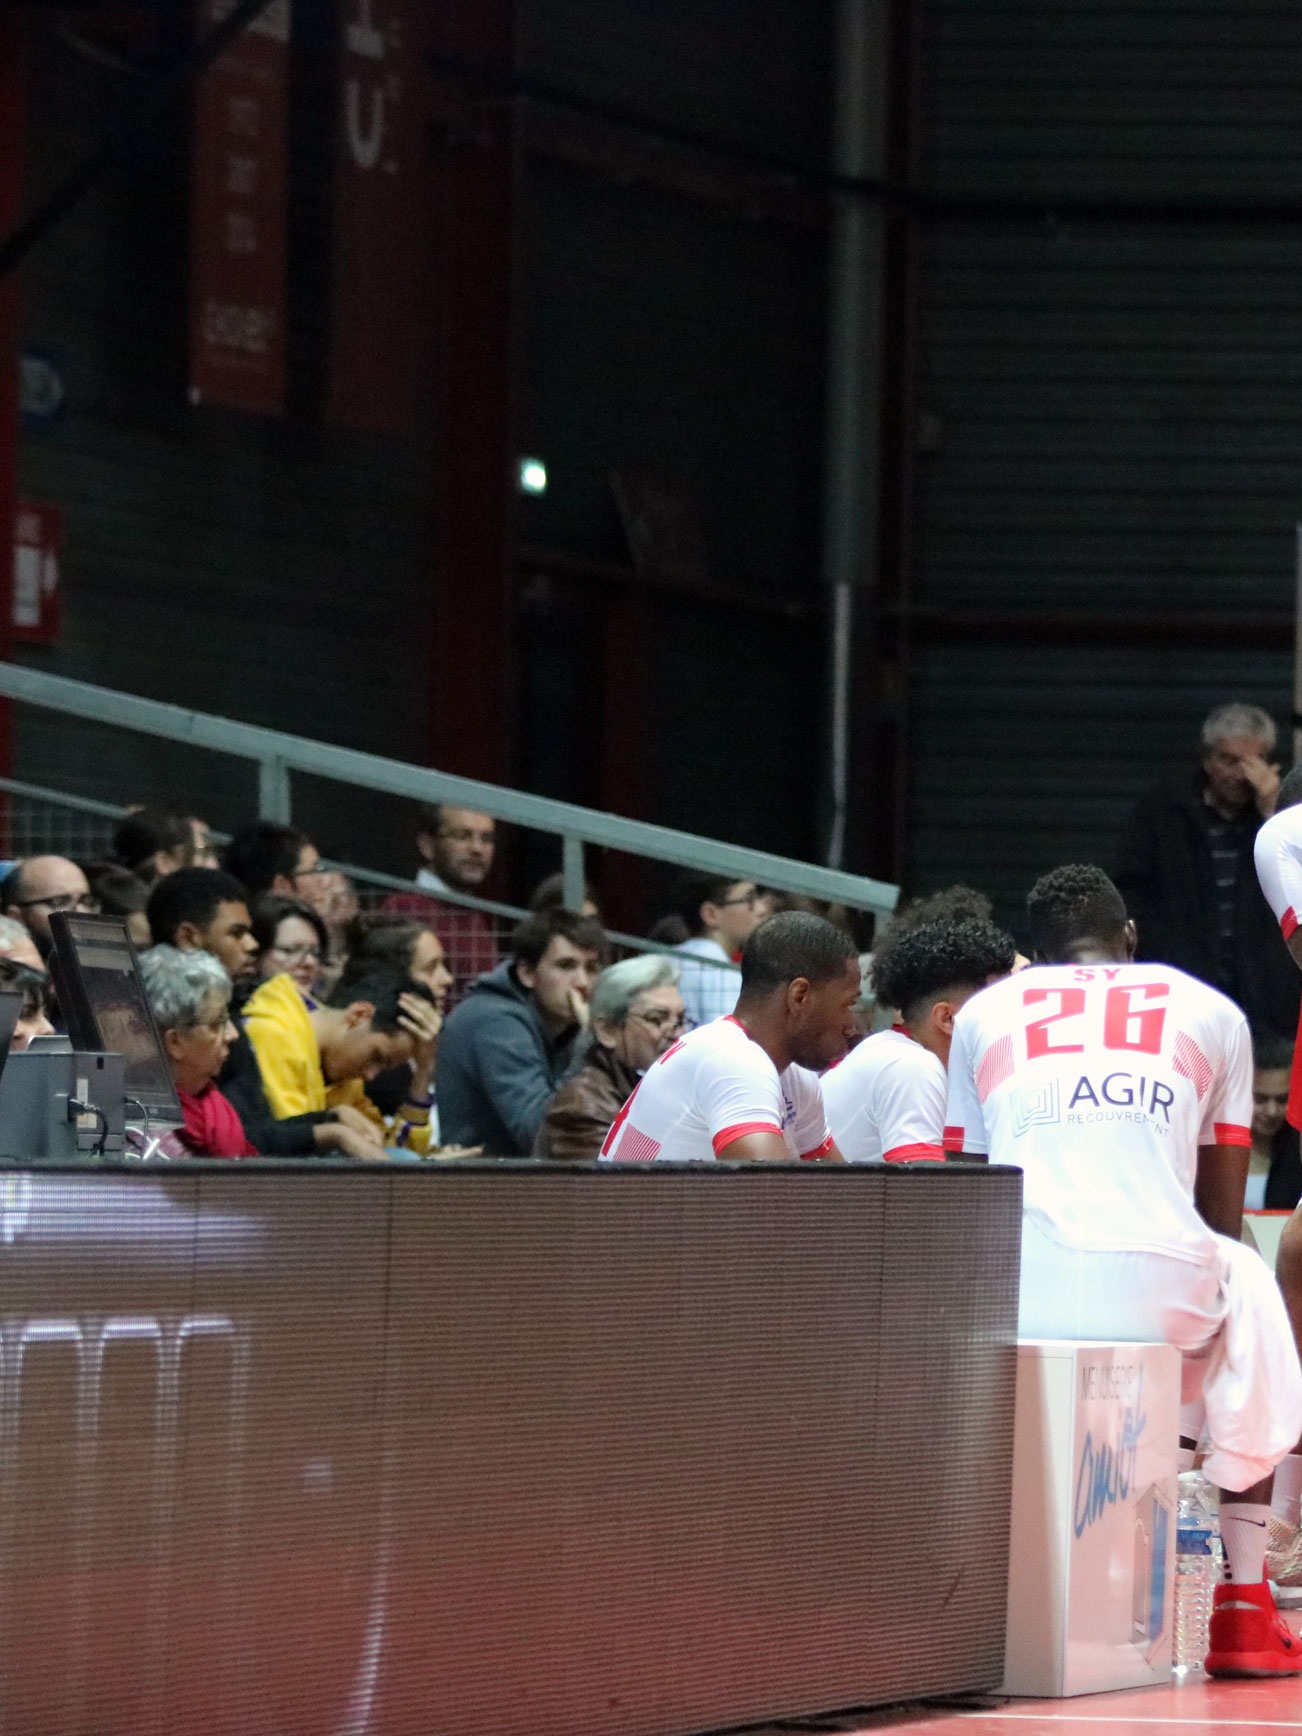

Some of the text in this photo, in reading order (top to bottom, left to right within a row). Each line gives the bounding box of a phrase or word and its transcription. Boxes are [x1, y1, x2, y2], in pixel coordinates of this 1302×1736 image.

[1073, 967, 1122, 982] SY
[1023, 982, 1170, 1060] 26
[1068, 1072, 1175, 1124] AGIR
